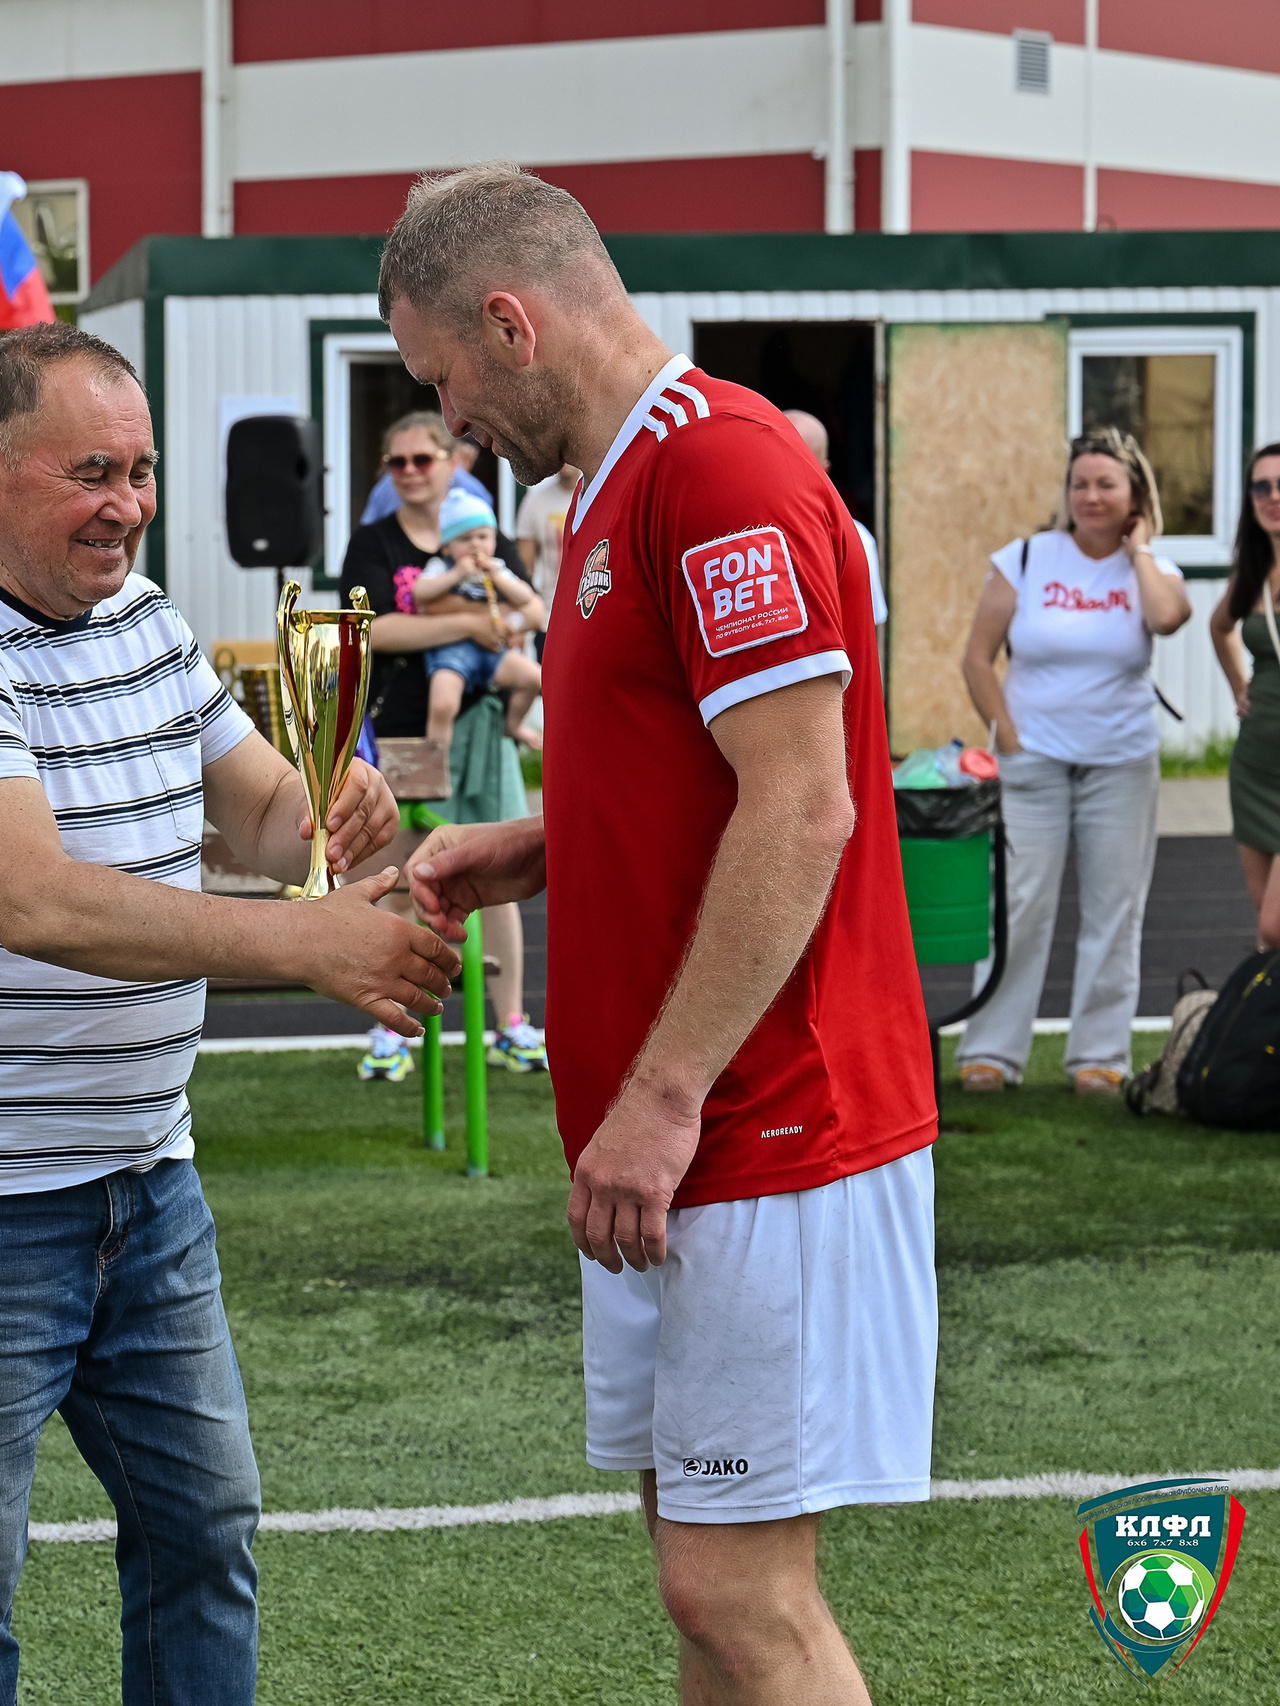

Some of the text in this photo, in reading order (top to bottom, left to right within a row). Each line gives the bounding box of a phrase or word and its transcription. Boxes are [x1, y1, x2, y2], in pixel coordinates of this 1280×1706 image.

[703, 544, 772, 590] FON
[712, 573, 779, 621] BET
[715, 607, 789, 632] ЧЕМПИОНАТ РОССИИ
[724, 624, 751, 637] ФУТБОЛУ
[761, 1125, 803, 1139] AEROREADY
[701, 1458, 749, 1476] JAKO
